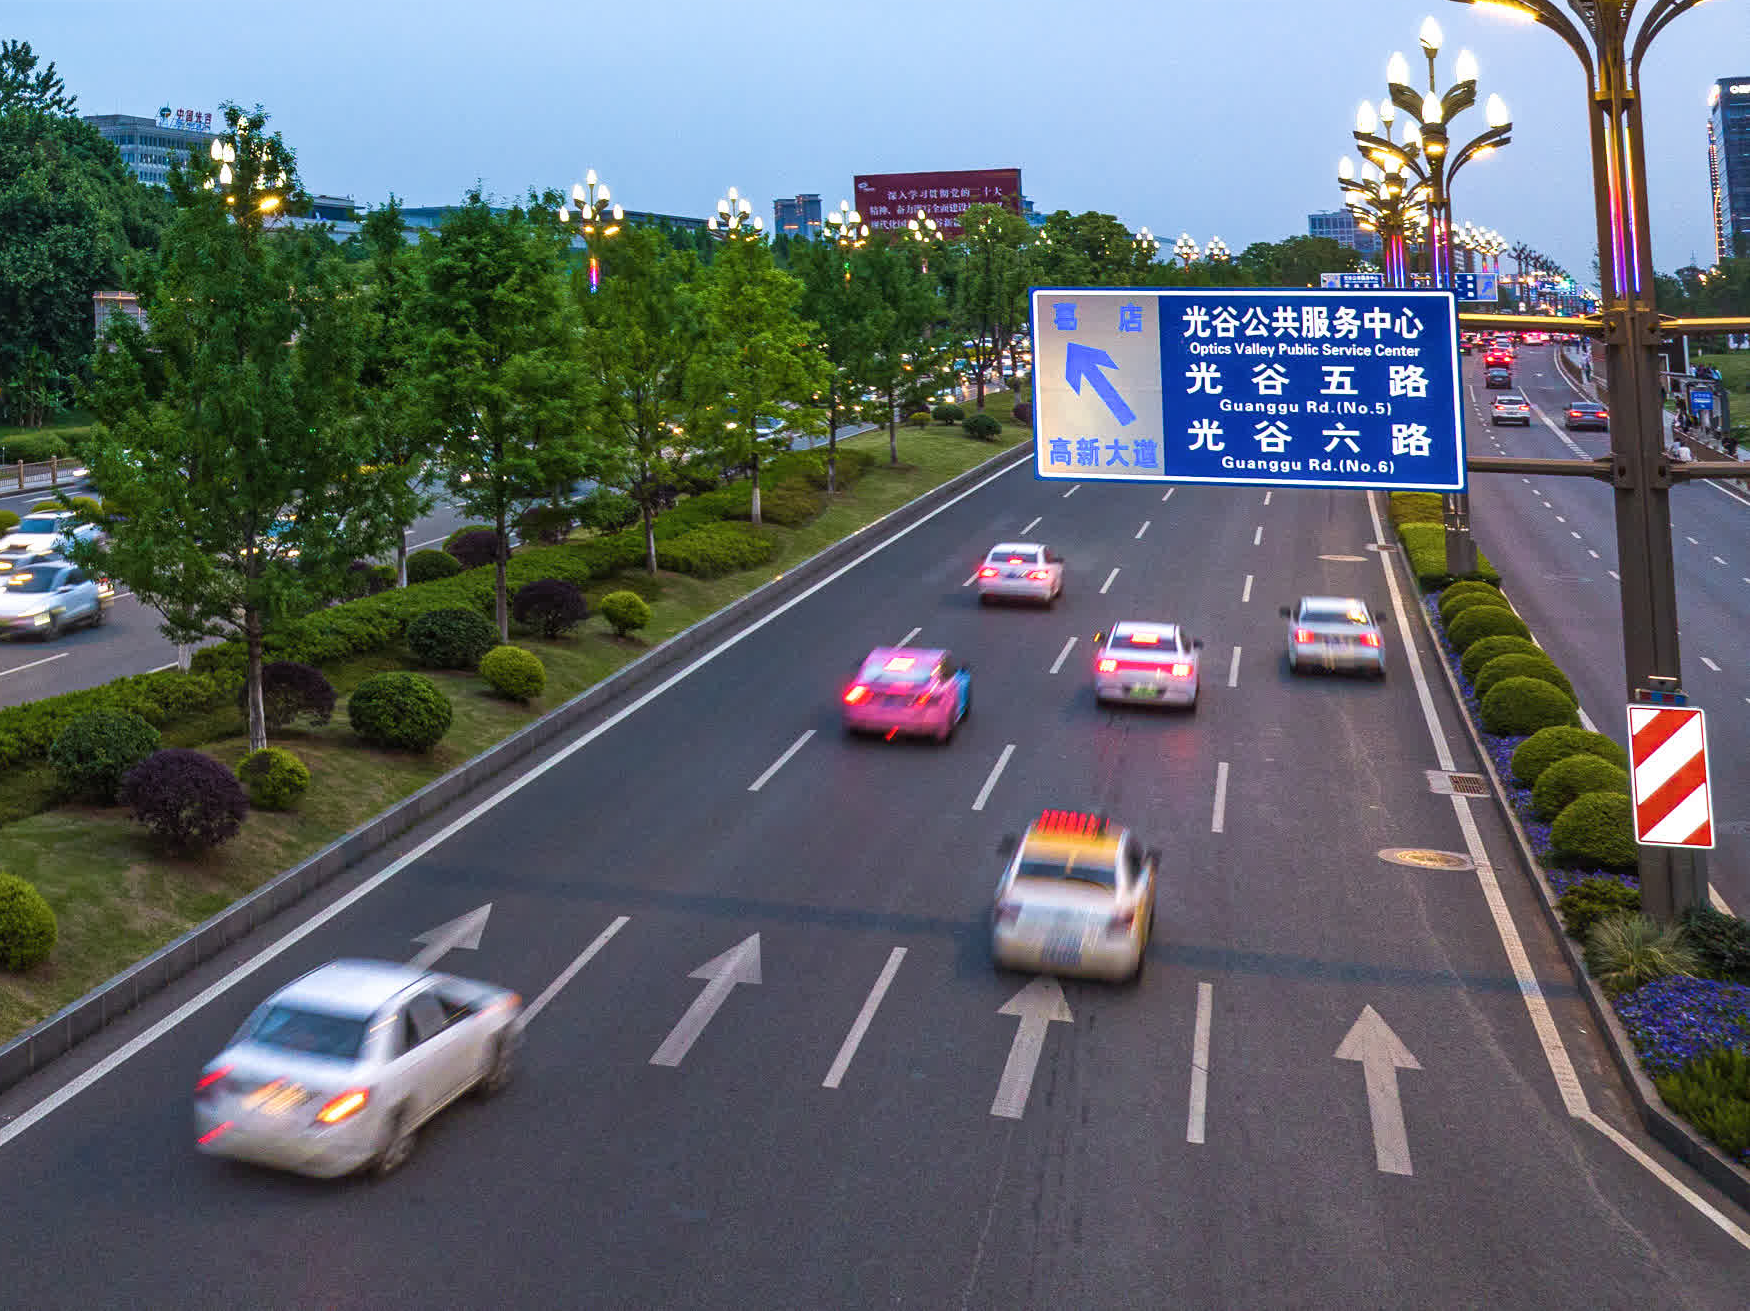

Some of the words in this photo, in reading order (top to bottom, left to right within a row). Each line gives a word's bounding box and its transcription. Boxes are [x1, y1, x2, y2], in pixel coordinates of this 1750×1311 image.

[1182, 305, 1424, 339] 光谷公共服务中心
[1190, 341, 1232, 357] Optics
[1235, 342, 1275, 358] Valley
[1279, 343, 1319, 356] Public
[1322, 343, 1371, 357] Service
[1375, 343, 1421, 357] Center
[1185, 361, 1429, 398] 光谷五路
[1219, 398, 1299, 415] Guanggu
[1306, 400, 1392, 416] Rd.(No.5)
[1049, 437, 1159, 469] 高新大道
[1187, 418, 1433, 457] 光谷六路
[1221, 455, 1302, 473] Guanggu
[1308, 458, 1395, 475] Rd.(No.6)
